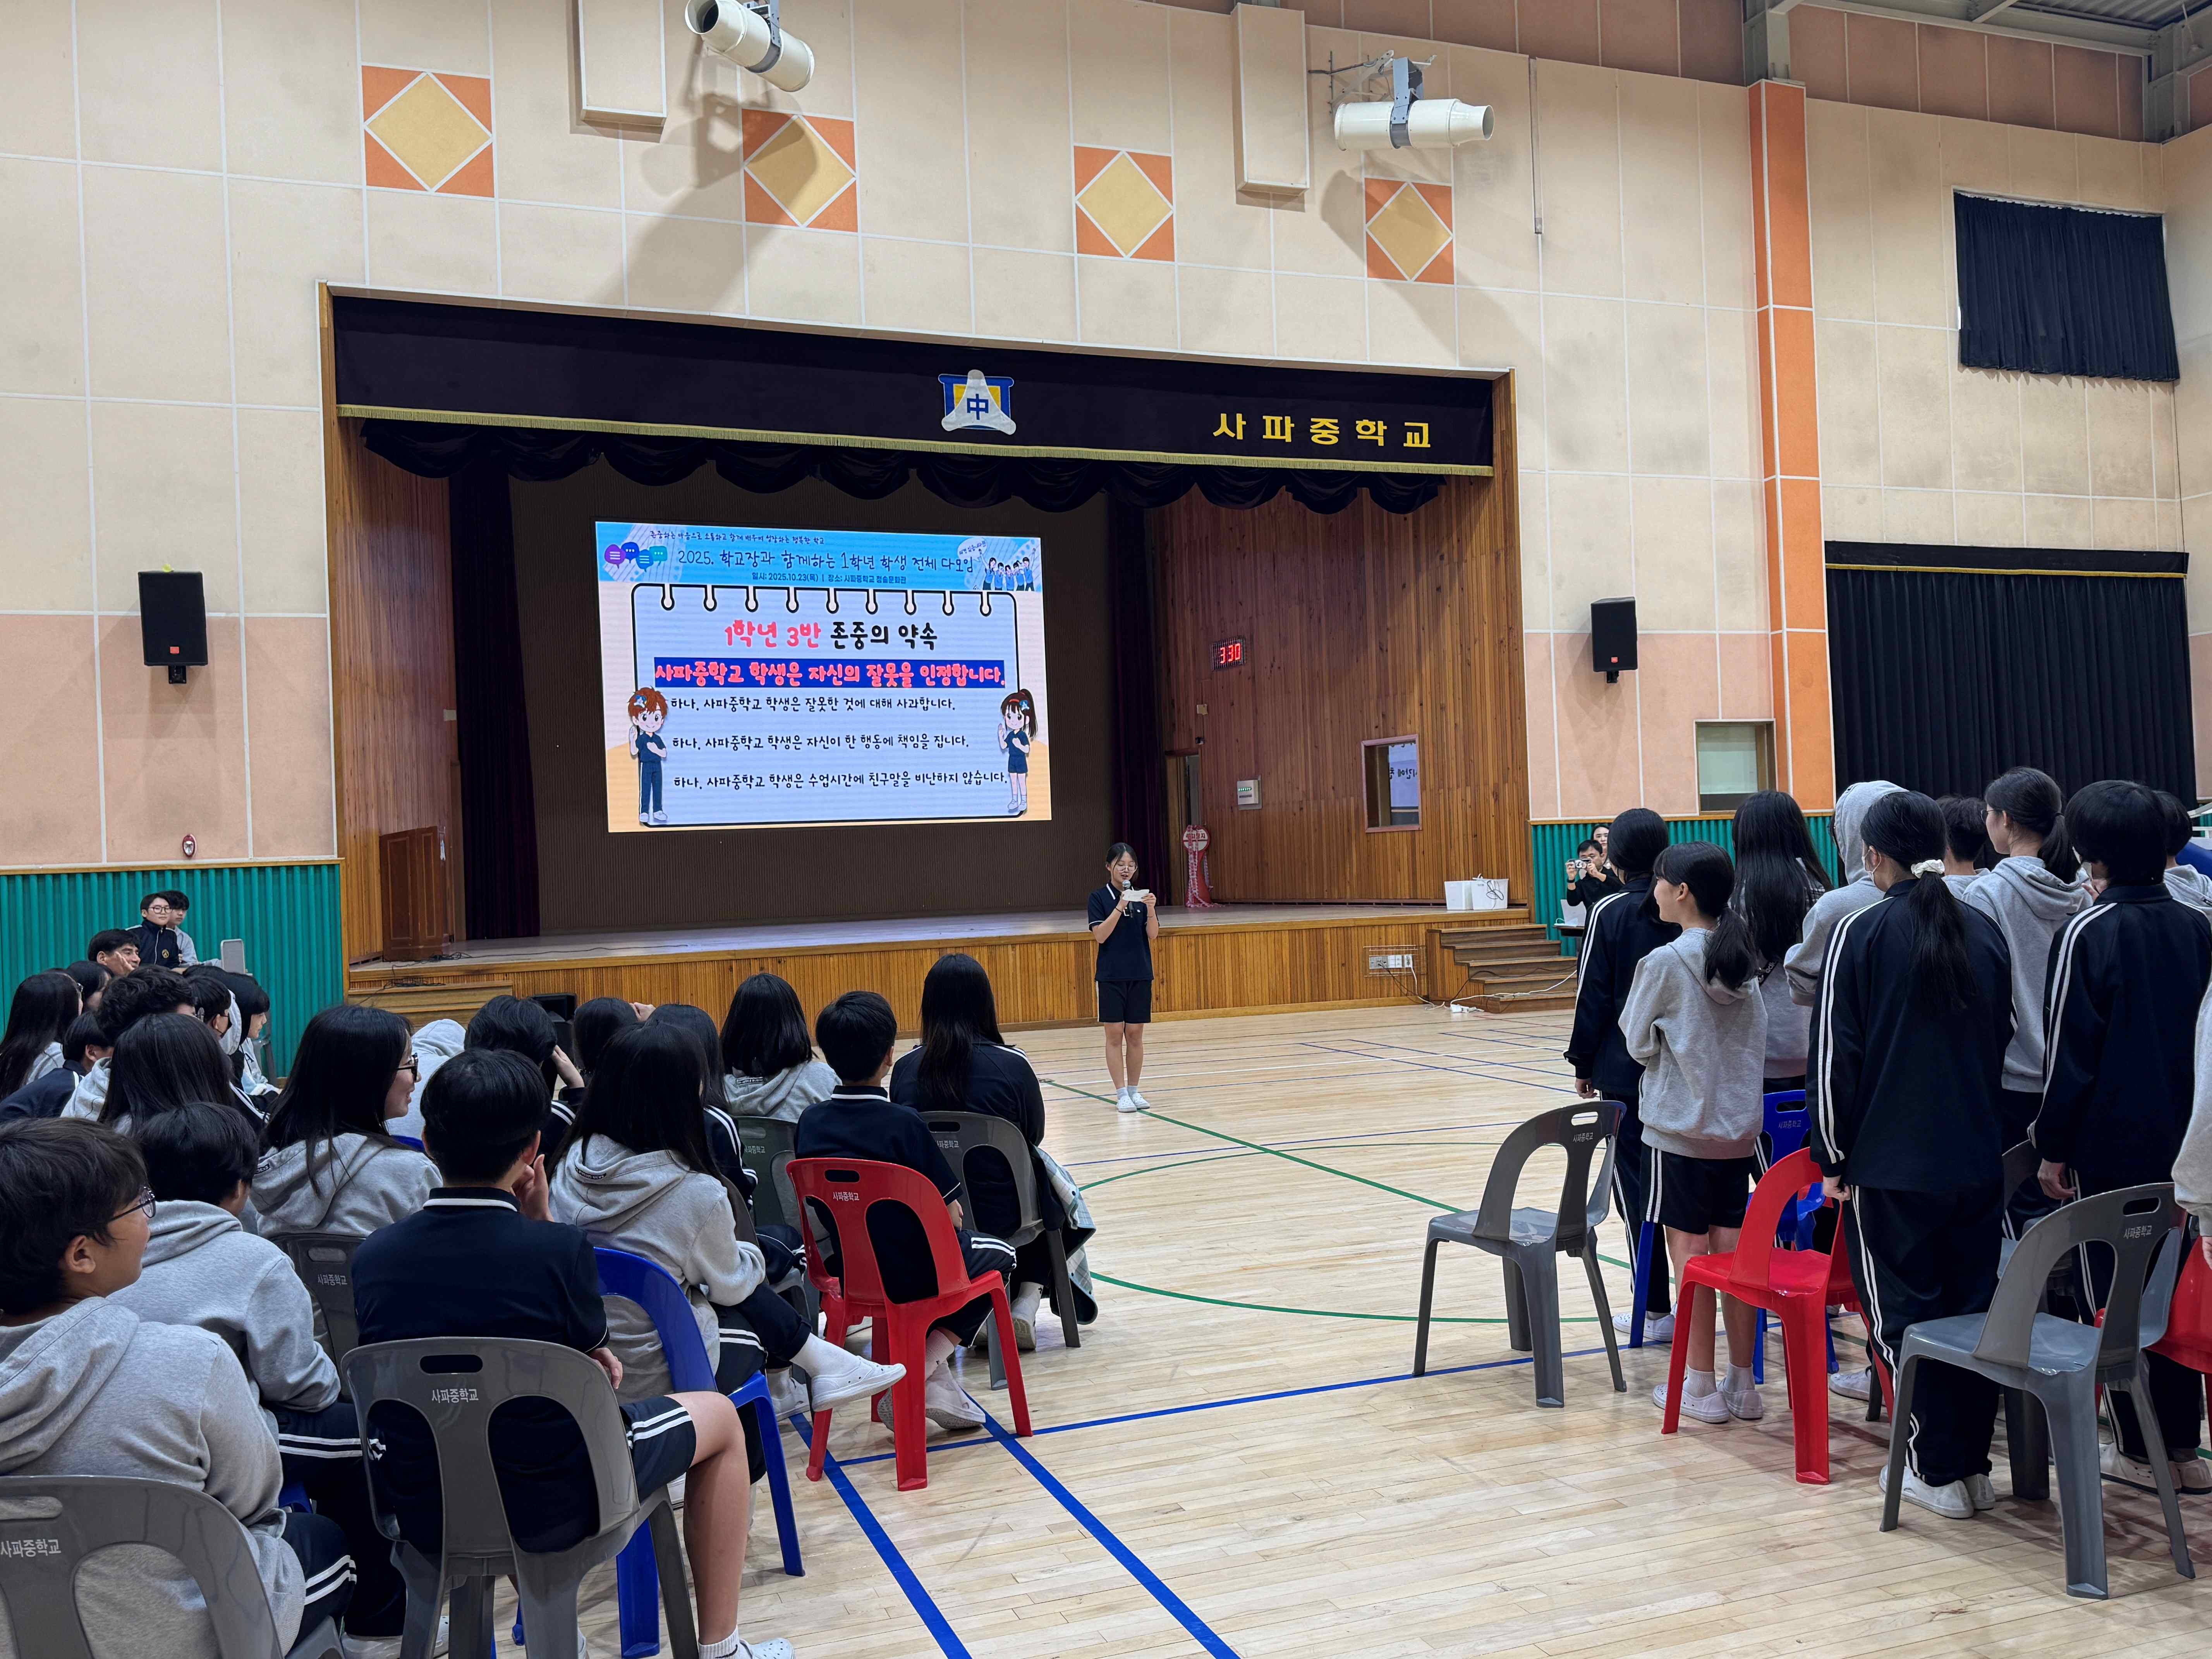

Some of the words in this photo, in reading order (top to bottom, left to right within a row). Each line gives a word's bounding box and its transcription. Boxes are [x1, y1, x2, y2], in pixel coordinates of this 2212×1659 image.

[967, 393, 989, 420] 中
[1212, 413, 1431, 448] 사파중학교
[650, 531, 675, 539] 존중하는
[704, 532, 727, 541] 소통하고
[766, 534, 790, 543] 성장하는
[792, 536, 811, 544] 행복한
[813, 536, 824, 544] 학교
[678, 550, 714, 565] 2025.
[719, 549, 775, 568] 학교장과
[781, 550, 836, 569] 함께하는
[841, 552, 875, 571] 1학년
[880, 554, 907, 572] 학생
[912, 556, 937, 572] 전체
[941, 556, 973, 573] 다모임
[752, 572, 767, 580] 일시:
[768, 573, 818, 582] 2025.10.23(목)
[828, 574, 842, 582] 장소:
[844, 575, 875, 583] 사파중학교
[724, 619, 777, 648] 1학년
[786, 622, 822, 649] 3반
[830, 621, 889, 650] 존중의
[898, 622, 938, 651] 약속
[655, 661, 744, 687] 사파중학교
[749, 661, 803, 687] 학생은
[808, 663, 860, 686] 자신의
[866, 662, 914, 688] 잘못을
[919, 663, 1005, 687] 인정합니다.
[671, 698, 699, 711] 하나.
[703, 696, 762, 713] 사파중학교
[766, 697, 801, 712] 학생은
[805, 697, 838, 712] 잘못한
[843, 698, 866, 711] 것에
[870, 698, 892, 709] 대해
[896, 697, 955, 711] 사과합니다.
[672, 737, 701, 750] 하나.
[705, 735, 764, 751] 사파중학교
[768, 735, 802, 750] 학생은
[807, 735, 840, 750] 자신이
[845, 735, 857, 749] 한
[860, 734, 893, 750] 행동에
[898, 733, 929, 750] 책임을
[934, 735, 969, 749] 집니다.
[674, 776, 702, 790] 하나.
[707, 774, 765, 790] 사파중학교
[769, 773, 804, 789] 학생은
[808, 773, 864, 788] 수업시간에
[869, 771, 911, 787] 친구말을
[915, 772, 958, 786] 비난하지
[962, 769, 1008, 785] 않습니다.
[1573, 1132, 1594, 1143] 사파중학교
[833, 1192, 860, 1201] 사파중학교
[2123, 1225, 2152, 1239] 사파중학교
[318, 1274, 347, 1286] 사파중학교
[432, 1388, 479, 1403] 사파중학교
[0, 1539, 62, 1558] 사파중학교
